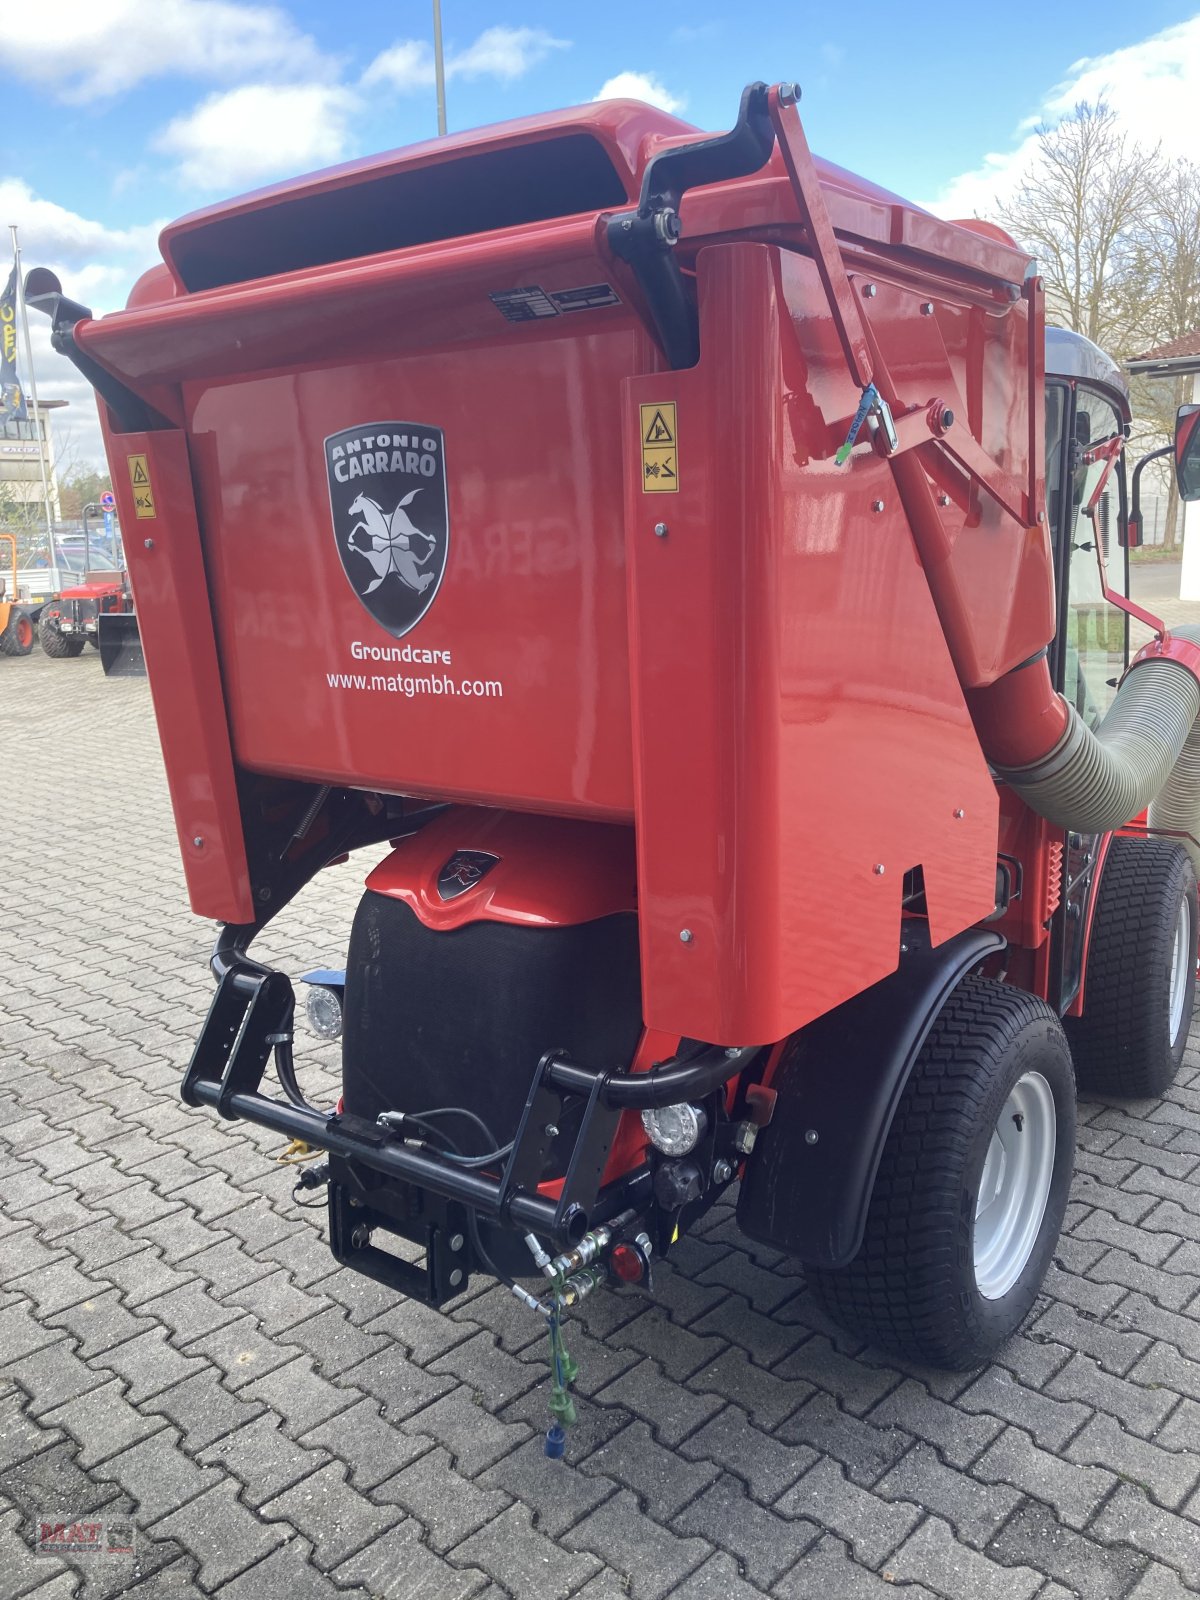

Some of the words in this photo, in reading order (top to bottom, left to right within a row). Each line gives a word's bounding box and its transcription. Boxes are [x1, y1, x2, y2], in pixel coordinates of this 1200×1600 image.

[332, 434, 438, 461] ANTONIO
[334, 450, 436, 483] CARRARO
[350, 641, 452, 665] Groundcare
[326, 673, 503, 698] www.matgmbh.com
